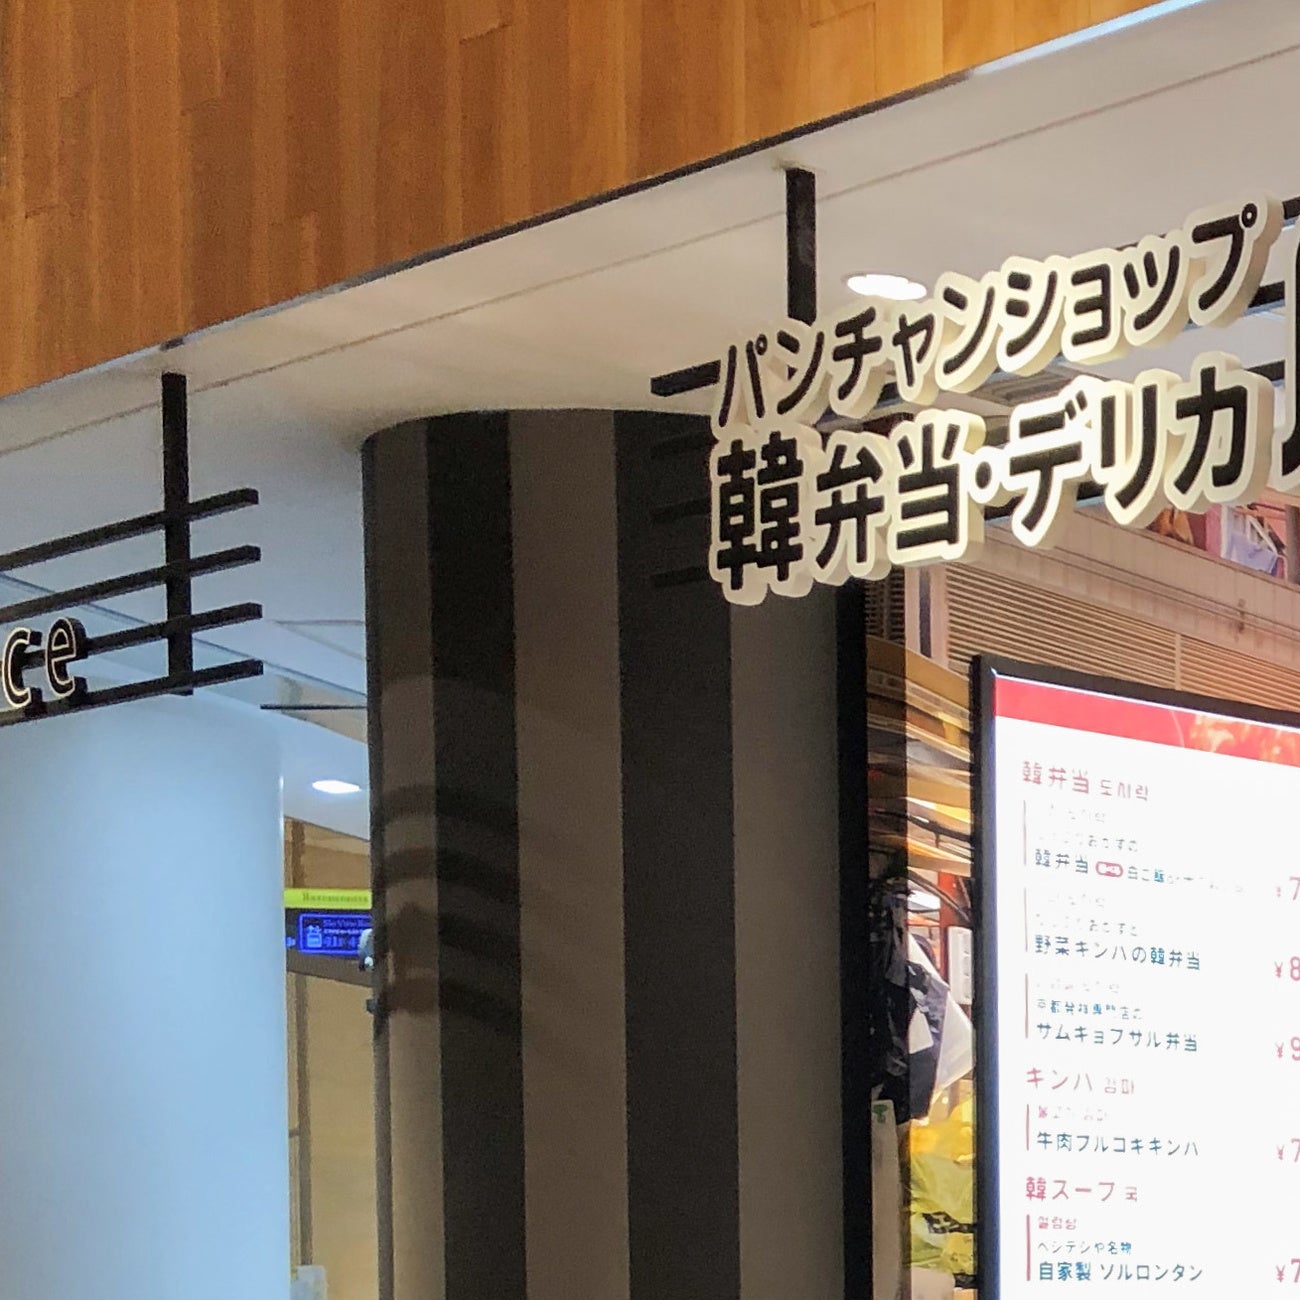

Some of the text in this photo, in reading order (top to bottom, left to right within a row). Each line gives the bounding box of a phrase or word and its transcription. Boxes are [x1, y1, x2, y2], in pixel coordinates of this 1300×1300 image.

[718, 203, 1262, 428] パンチャンショップ
